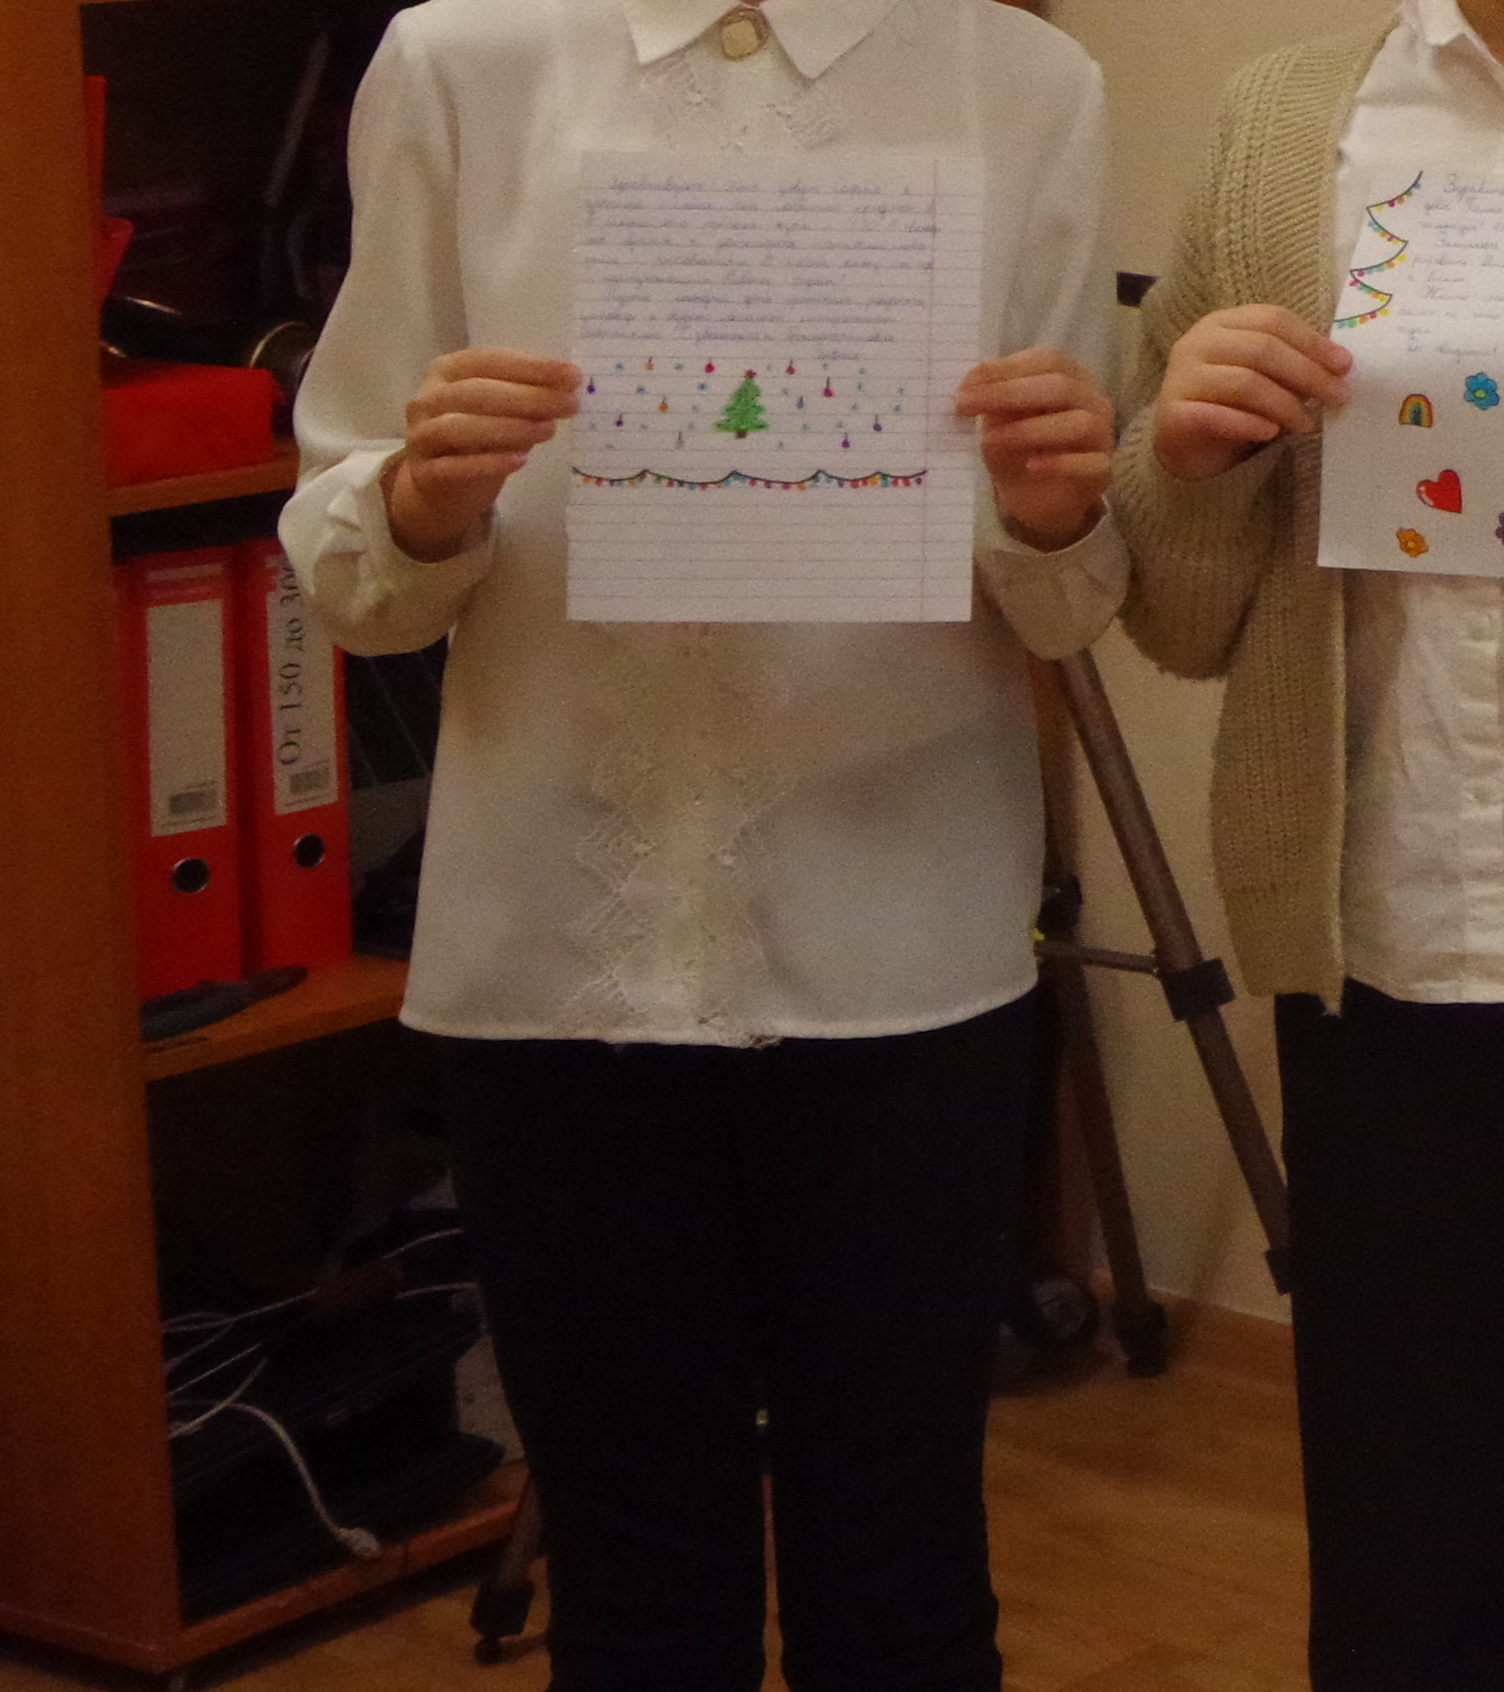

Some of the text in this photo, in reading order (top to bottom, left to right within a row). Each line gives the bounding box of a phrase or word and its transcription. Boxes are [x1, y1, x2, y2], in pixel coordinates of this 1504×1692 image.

[283, 618, 306, 652] до
[278, 662, 302, 712] 150
[276, 728, 301, 766] От
